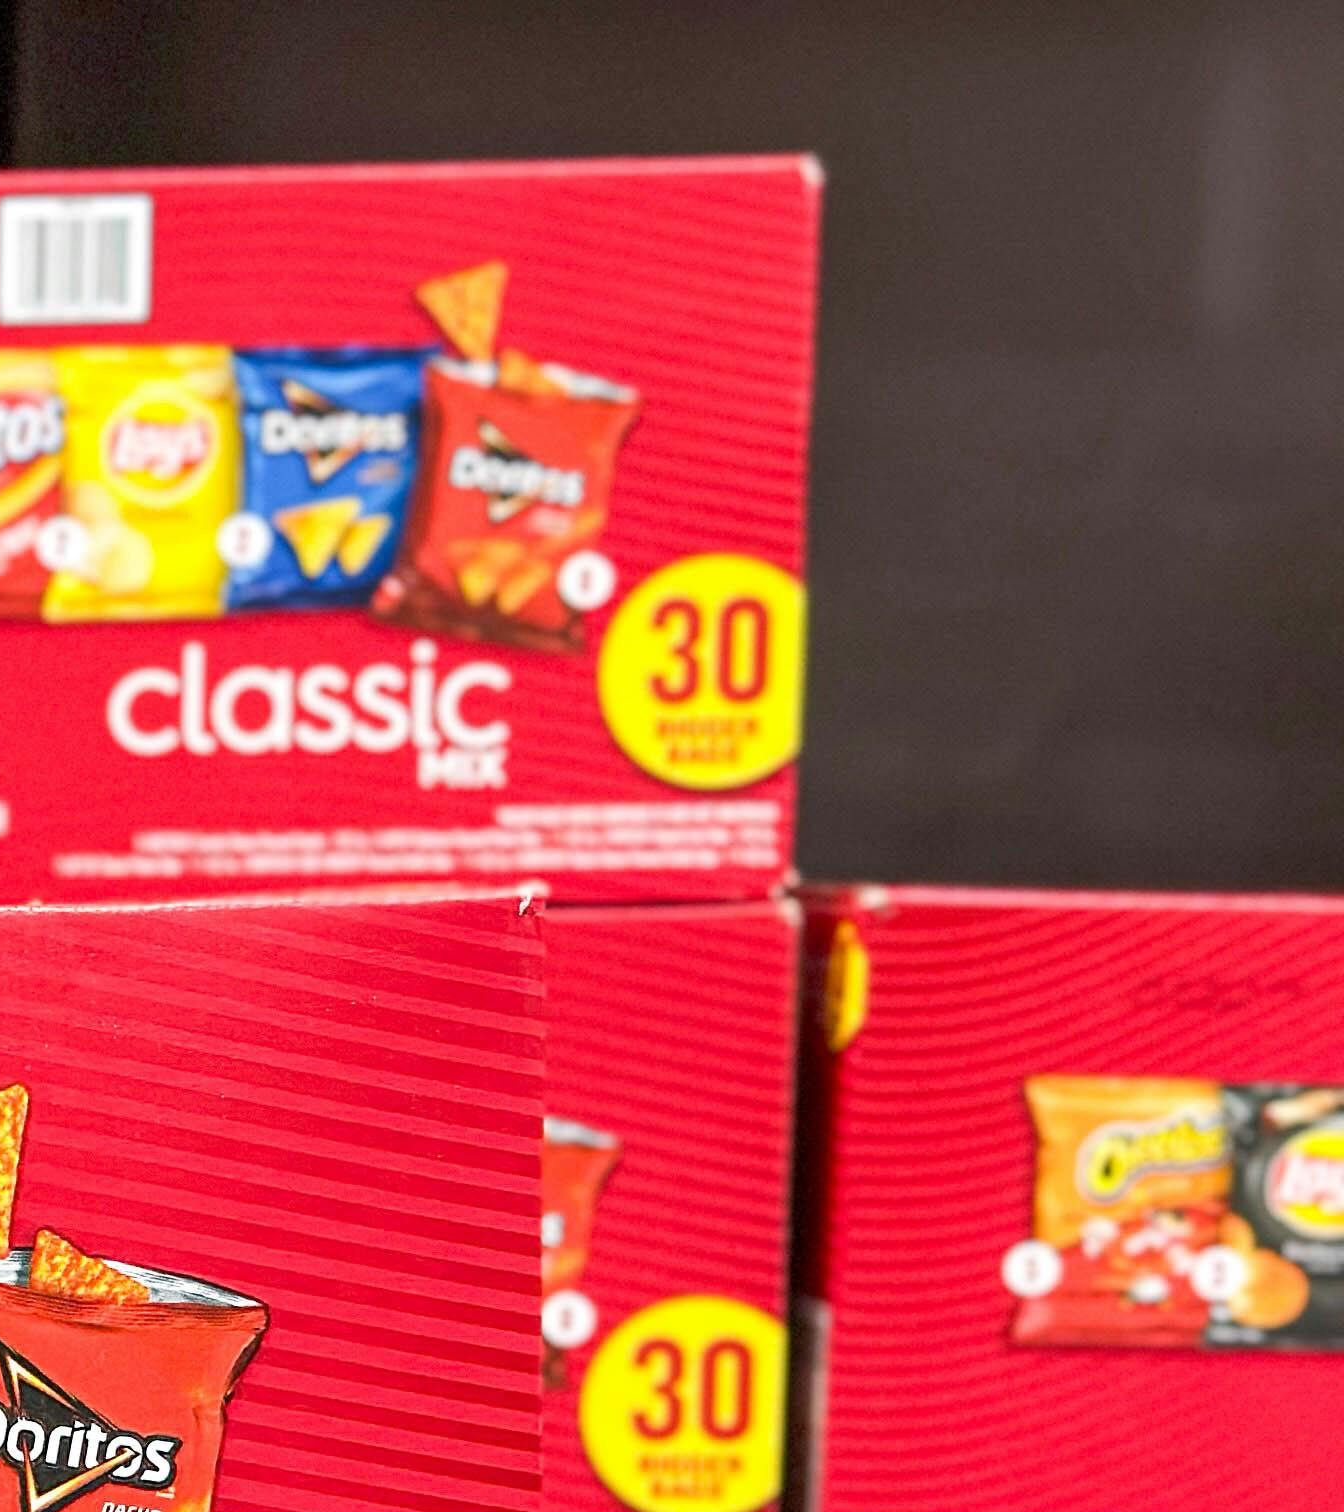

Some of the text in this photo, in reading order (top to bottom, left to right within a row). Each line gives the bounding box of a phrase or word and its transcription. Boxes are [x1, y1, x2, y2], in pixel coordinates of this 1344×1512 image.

[108, 641, 510, 755] classic
[650, 598, 770, 705] 30
[419, 749, 507, 789] MIX
[632, 1339, 753, 1441] 30
